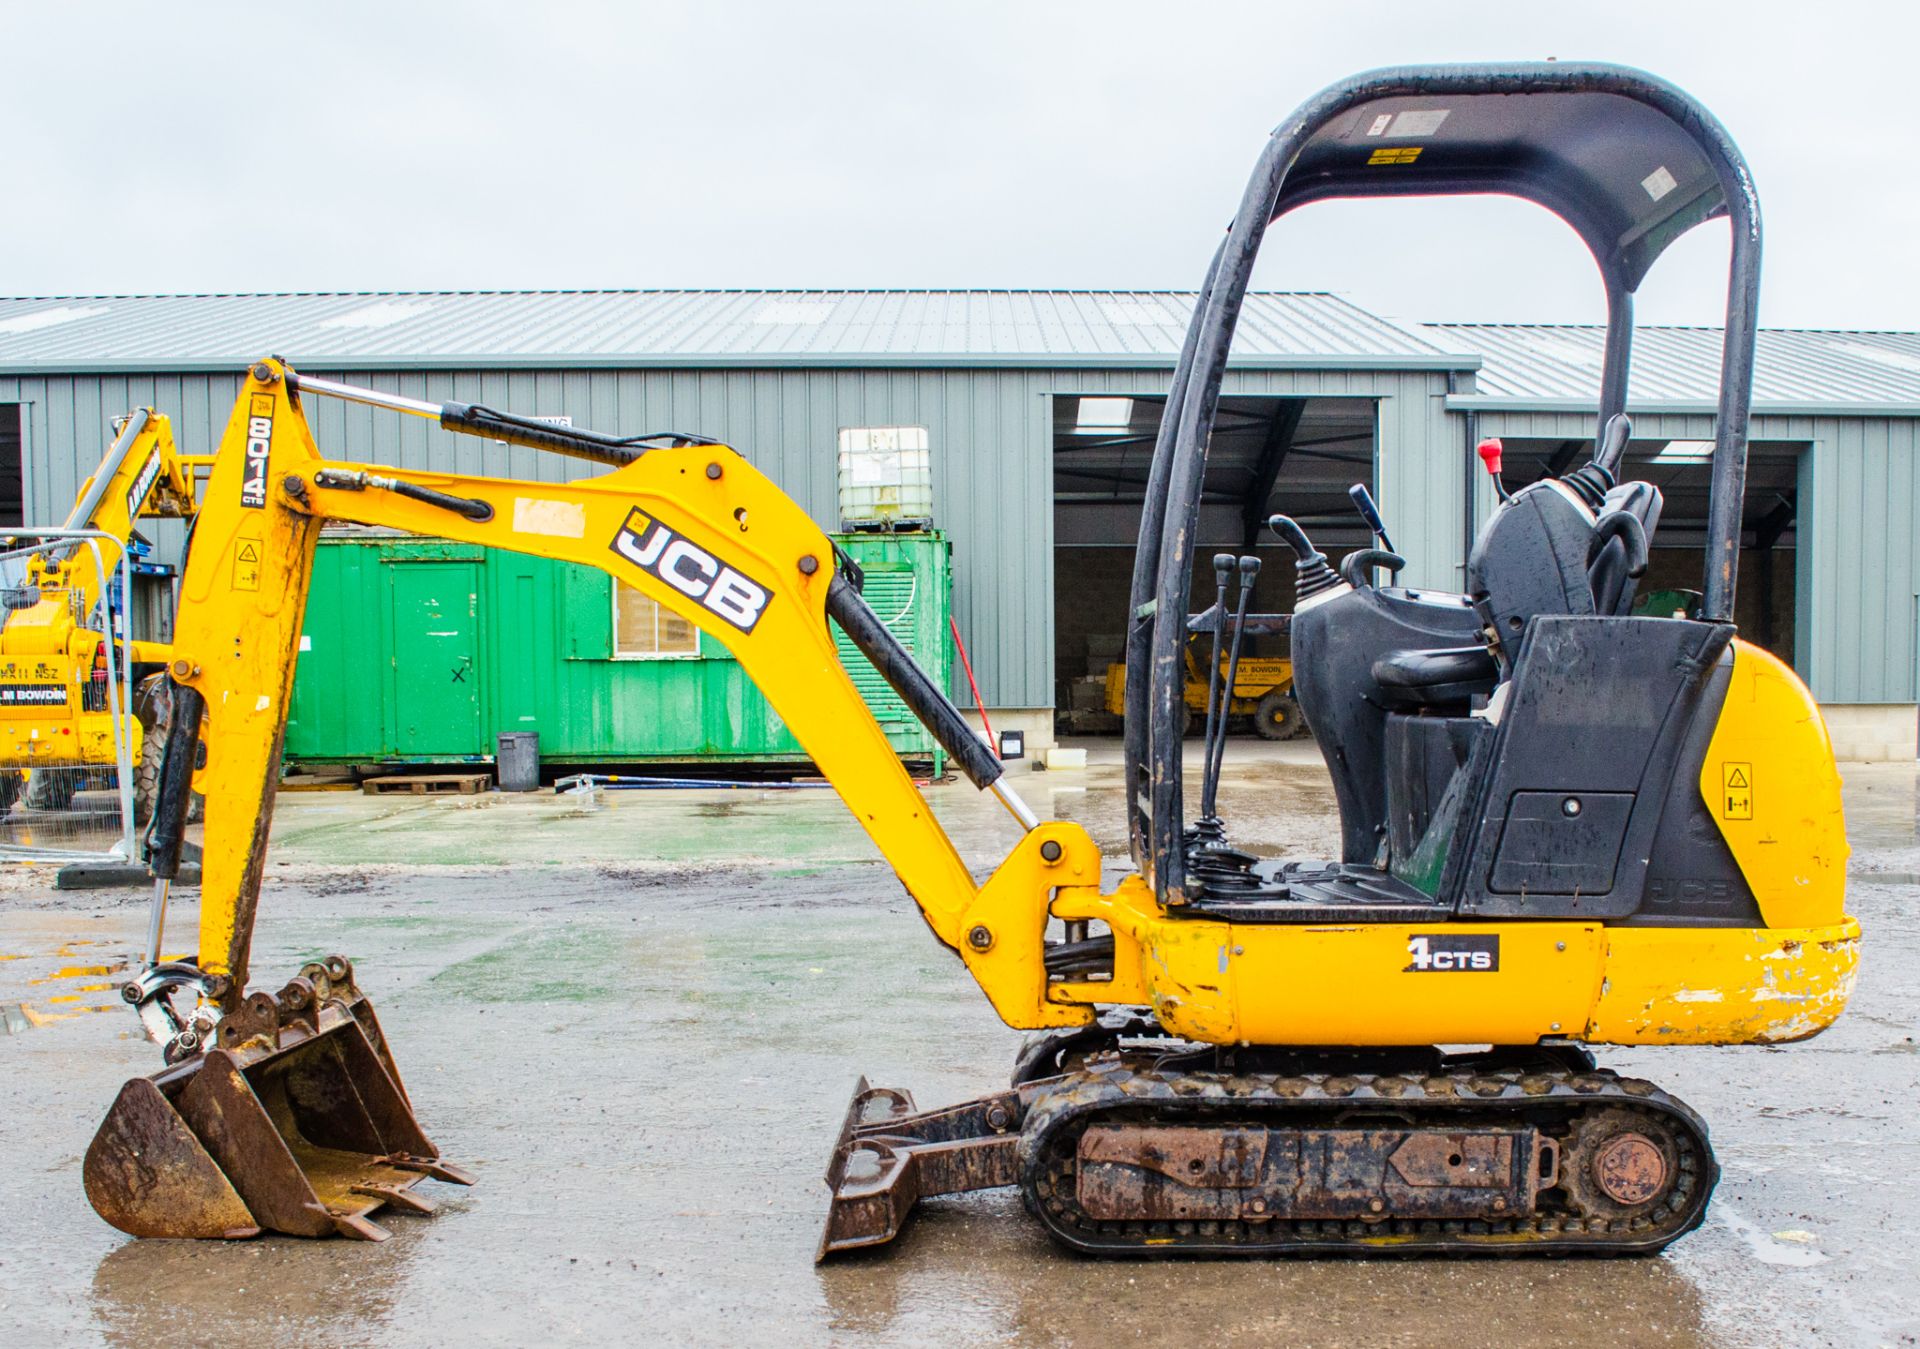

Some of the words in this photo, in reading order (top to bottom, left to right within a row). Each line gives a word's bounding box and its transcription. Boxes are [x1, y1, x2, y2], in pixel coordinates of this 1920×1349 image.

[243, 417, 272, 498] 8014
[242, 495, 264, 505] CTS
[616, 525, 767, 628] JCB
[16, 688, 67, 700] BOWDIN
[1652, 878, 1735, 904] JCB
